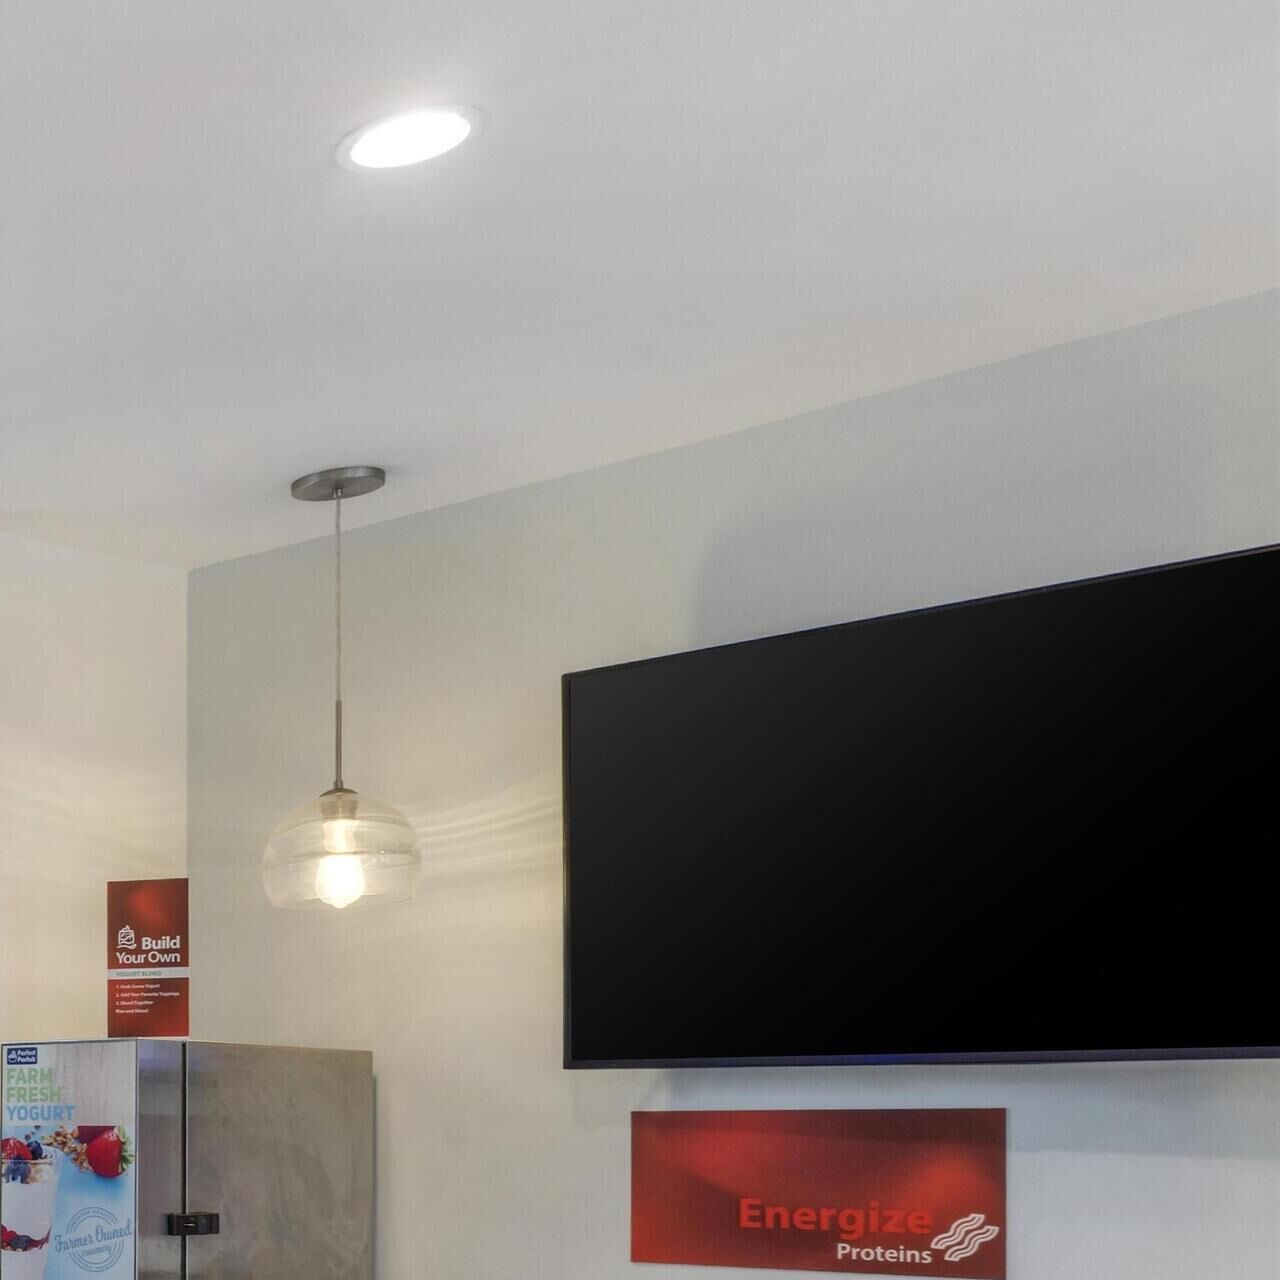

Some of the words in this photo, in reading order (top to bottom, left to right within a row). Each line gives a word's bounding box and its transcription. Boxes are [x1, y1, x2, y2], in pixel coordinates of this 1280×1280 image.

[141, 936, 180, 950] Build
[116, 951, 146, 964] Your
[148, 951, 180, 963] Own
[7, 1067, 53, 1085] FARM
[7, 1086, 62, 1104] FRESH
[6, 1103, 75, 1121] YOGURT
[740, 1197, 933, 1241] Energize
[54, 1233, 94, 1252] Farmer
[95, 1218, 132, 1243] Owned
[836, 1243, 933, 1264] Proteins
